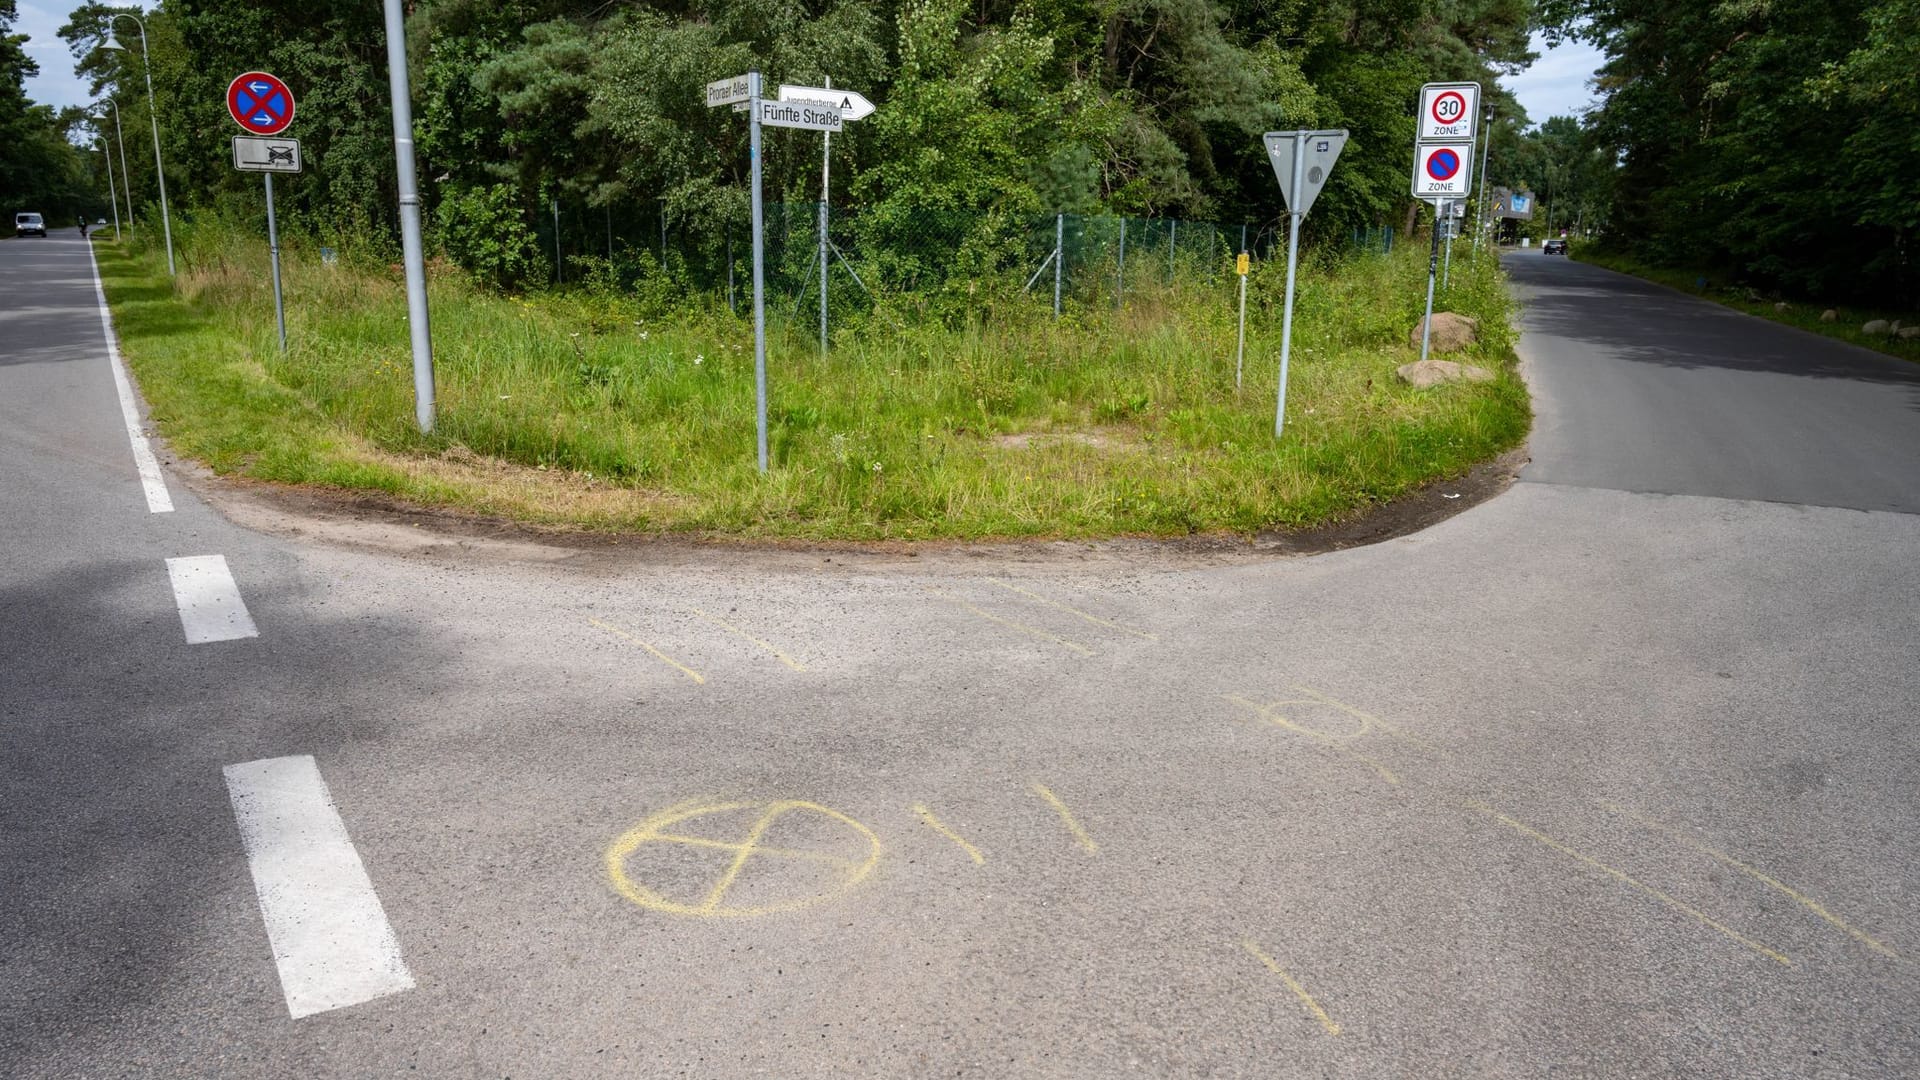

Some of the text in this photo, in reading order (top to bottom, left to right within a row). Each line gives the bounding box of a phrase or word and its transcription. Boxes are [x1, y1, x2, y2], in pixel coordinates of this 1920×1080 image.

[709, 82, 748, 100] Proraer Allee
[763, 104, 839, 126] Fünfte Straße
[1439, 100, 1459, 116] 30
[1433, 126, 1459, 135] ZONE
[1428, 183, 1454, 191] ZONE
